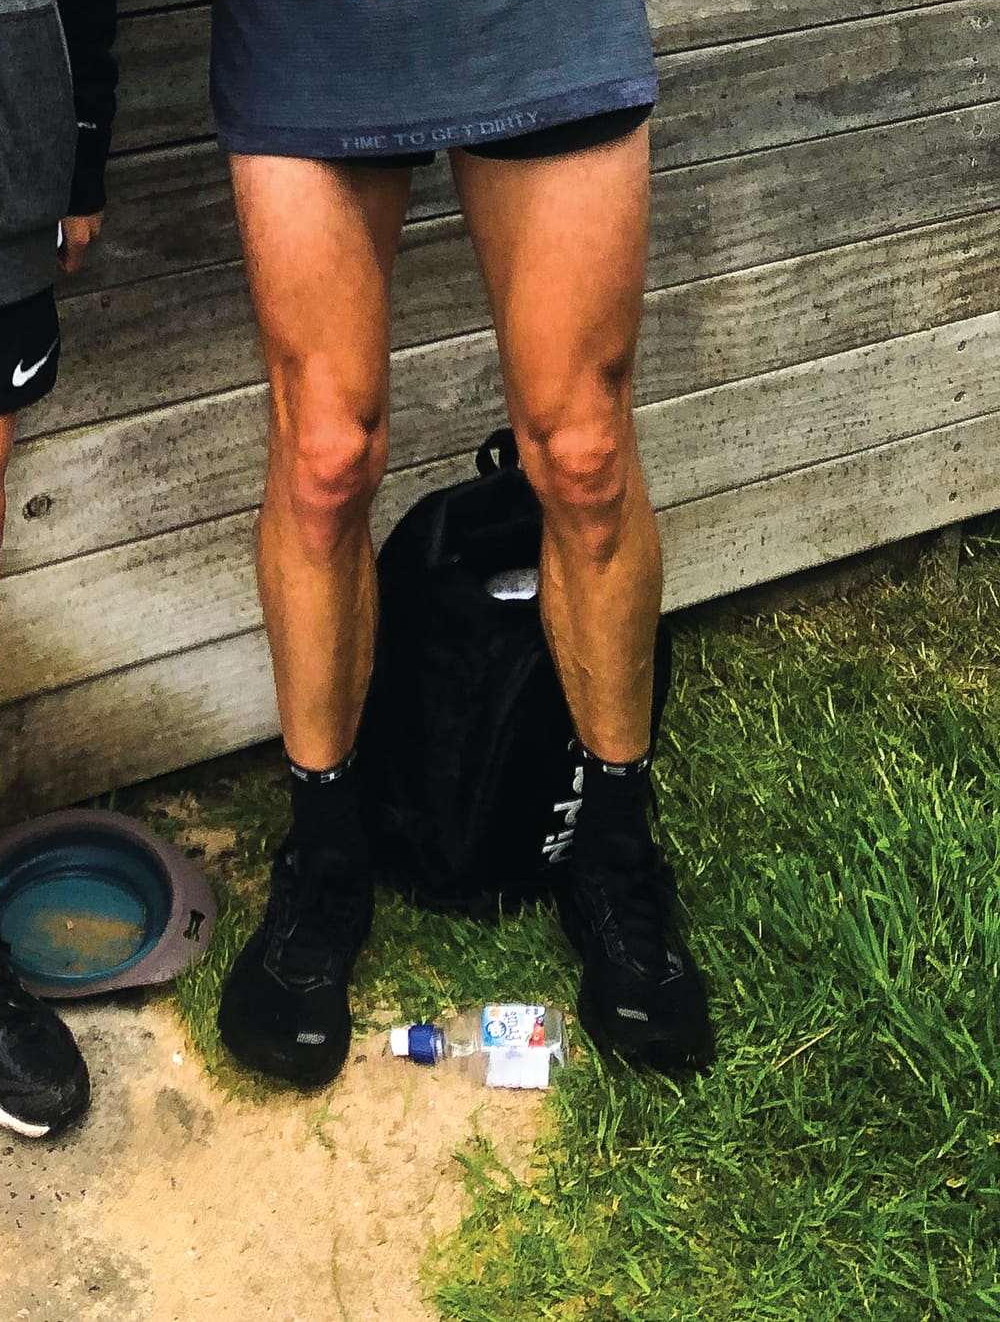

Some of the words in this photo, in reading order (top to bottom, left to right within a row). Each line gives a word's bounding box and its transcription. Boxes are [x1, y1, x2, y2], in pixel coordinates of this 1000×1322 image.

[339, 134, 386, 151] TIME
[393, 131, 426, 147] TO
[431, 124, 474, 142] GET
